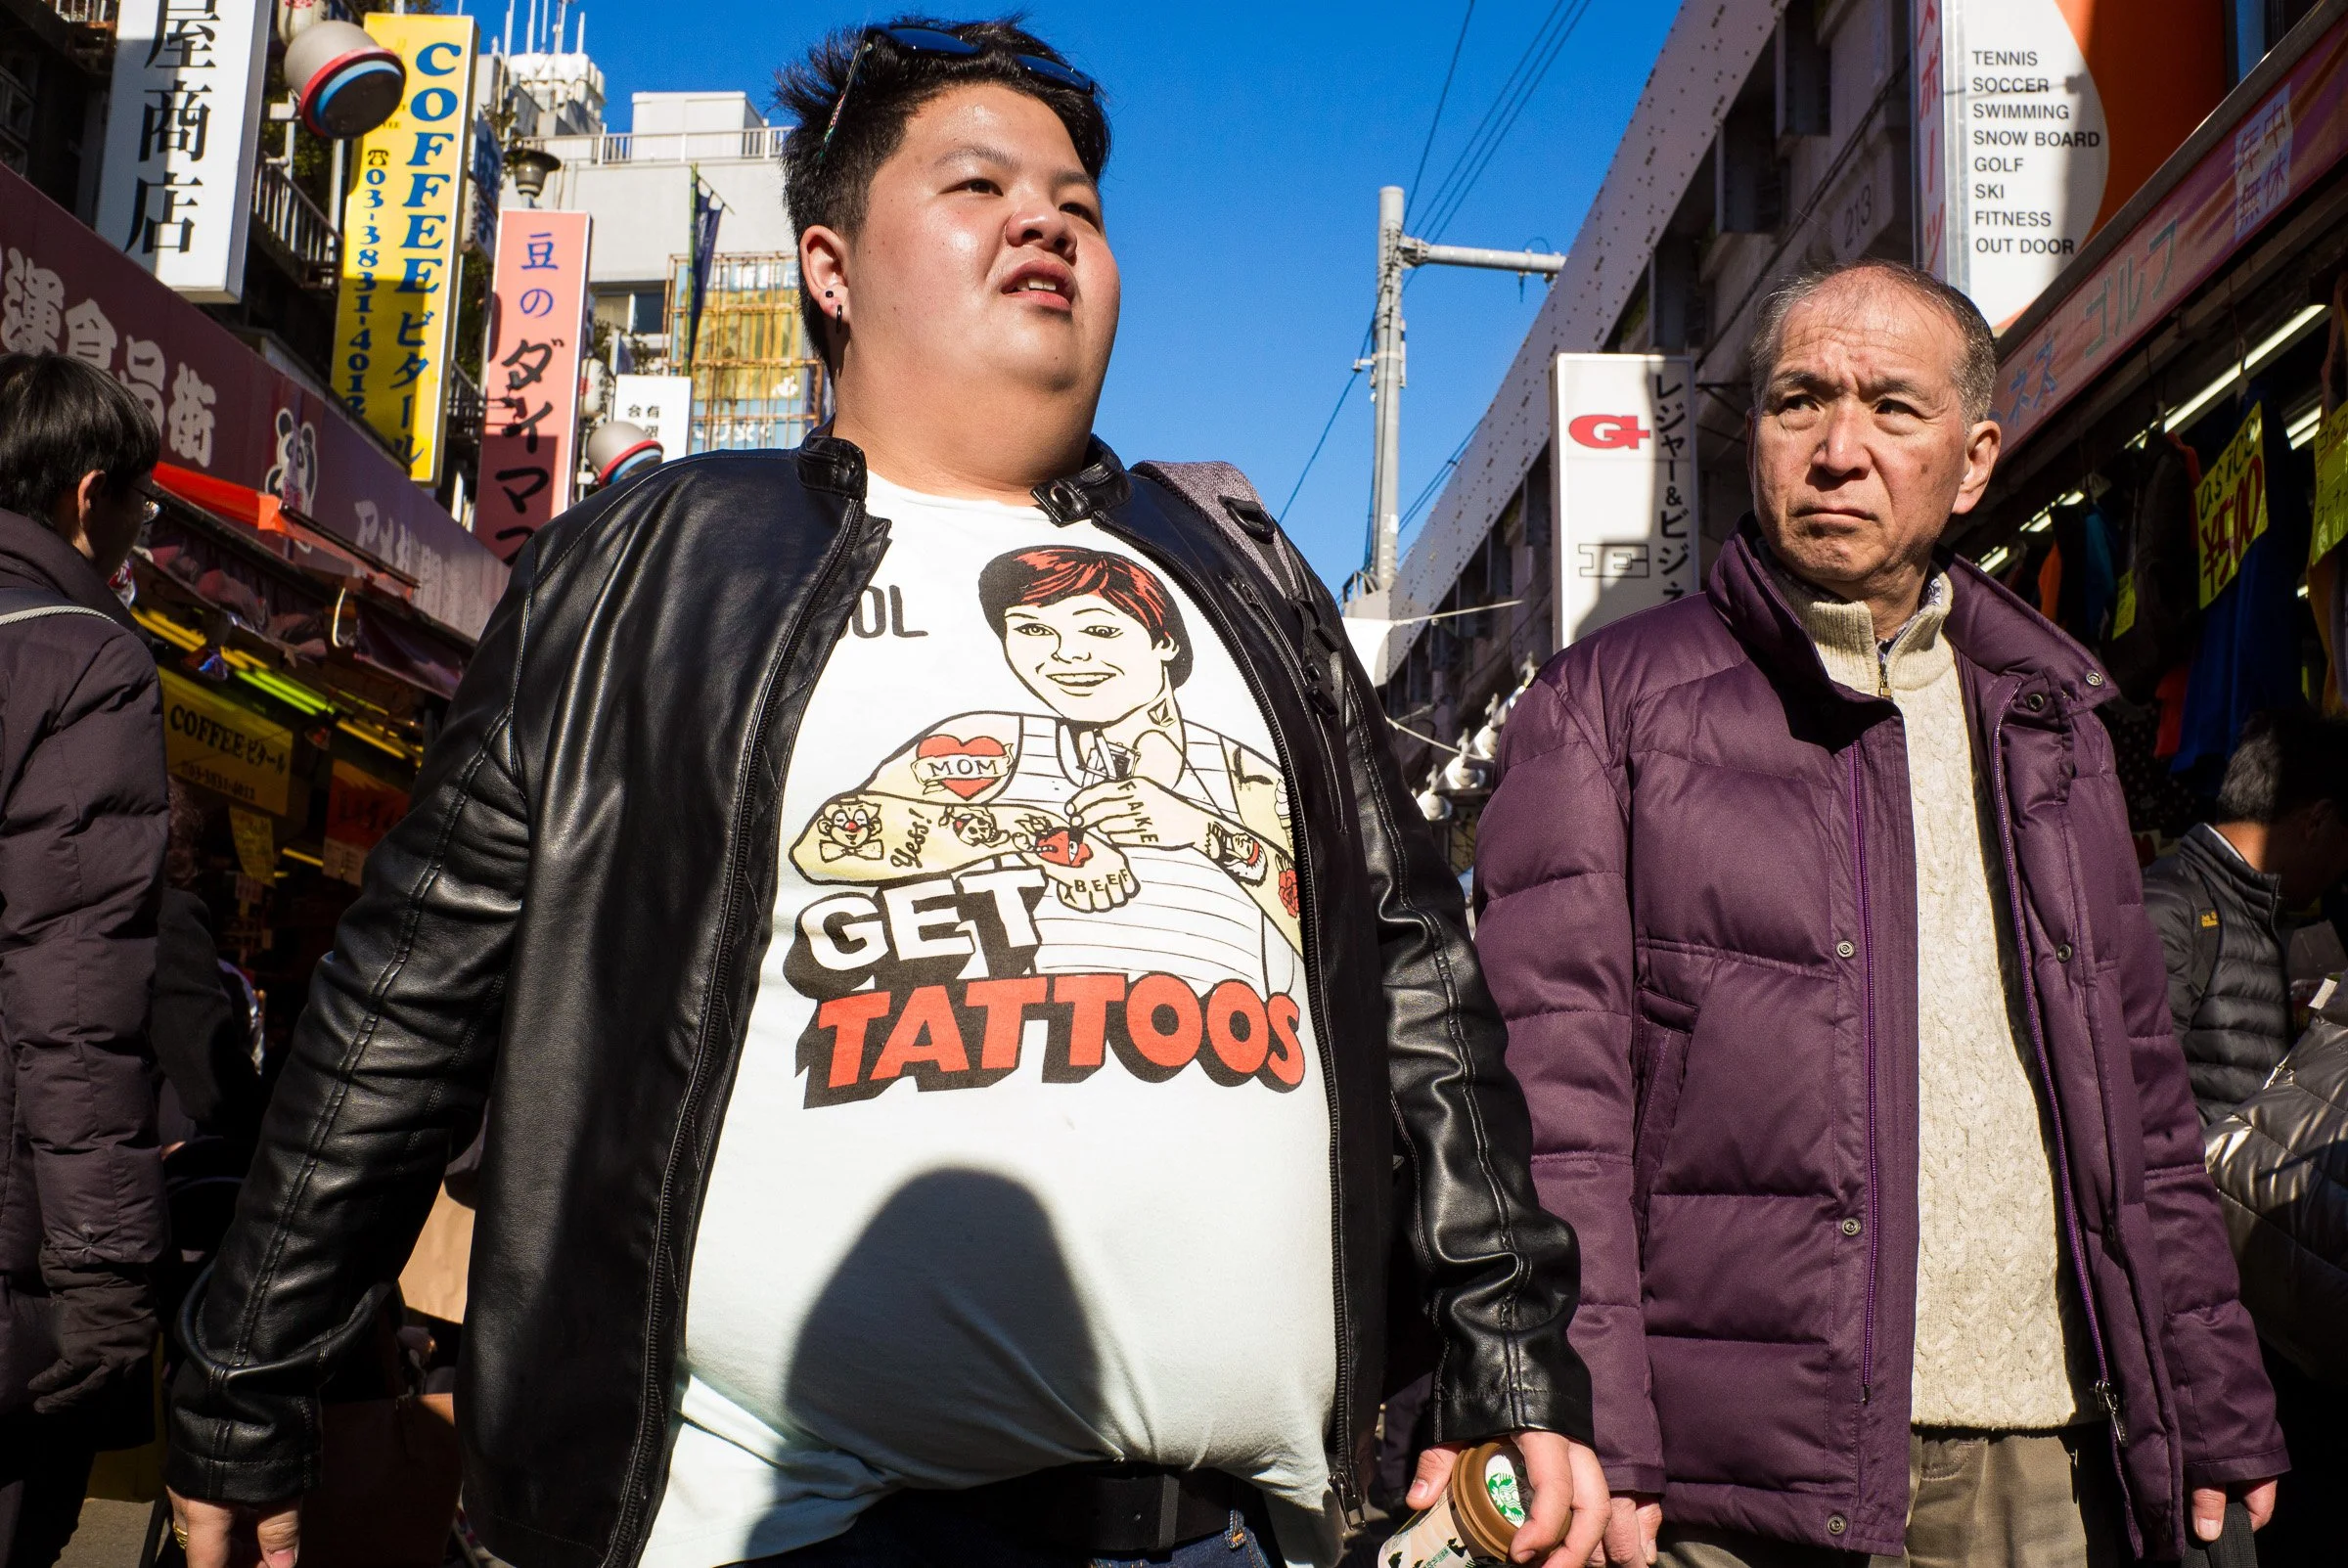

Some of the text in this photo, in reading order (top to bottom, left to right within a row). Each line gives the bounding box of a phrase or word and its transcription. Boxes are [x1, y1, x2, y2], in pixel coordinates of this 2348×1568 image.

[1972, 51, 2038, 67] TENNIS
[1972, 77, 2050, 93] SOCCER
[1973, 104, 2069, 119] SWIMMING
[1973, 130, 2100, 147] SNOW BOARD
[1974, 157, 2024, 172] GOLF
[1975, 184, 2005, 200] SKI
[1975, 211, 2052, 227] FITNESS
[390, 42, 462, 465] COFFEE ビタール
[1976, 238, 2074, 254] OUT DOOR
[344, 168, 386, 418] 03-3831-4012
[2085, 219, 2177, 360] ゴルフ
[839, 585, 928, 639] OL
[170, 703, 245, 758] COFFEE
[927, 758, 998, 777] MOM
[1117, 781, 1159, 844] FAKE
[1074, 869, 1129, 892] BEEF
[797, 868, 1045, 974] GET
[817, 973, 1306, 1090] TATTOOS
